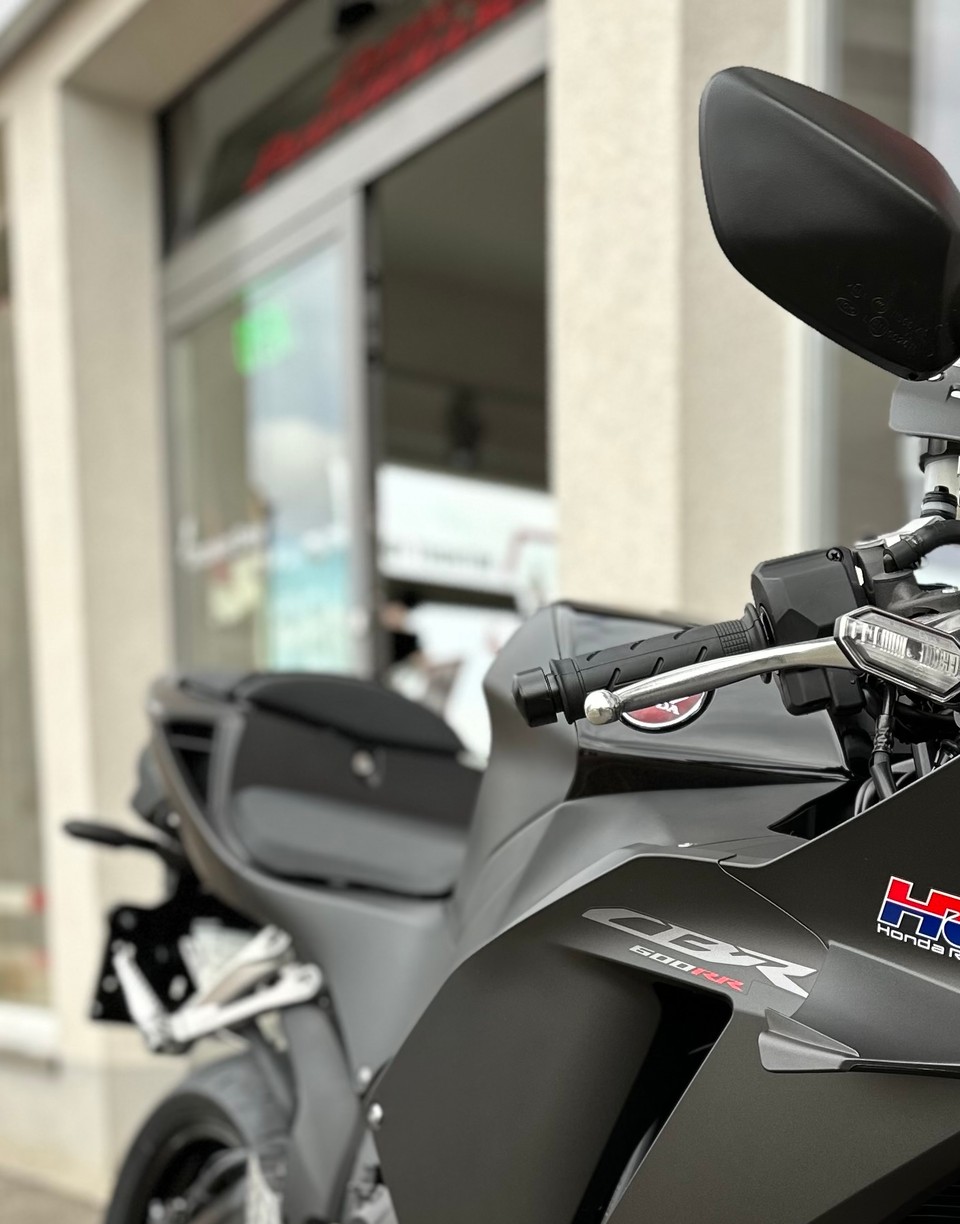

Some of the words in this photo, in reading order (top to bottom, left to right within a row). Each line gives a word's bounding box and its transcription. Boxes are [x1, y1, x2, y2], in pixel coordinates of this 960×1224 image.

[582, 908, 818, 999] CBR
[876, 923, 945, 955] Honda
[629, 944, 744, 992] 600RR
